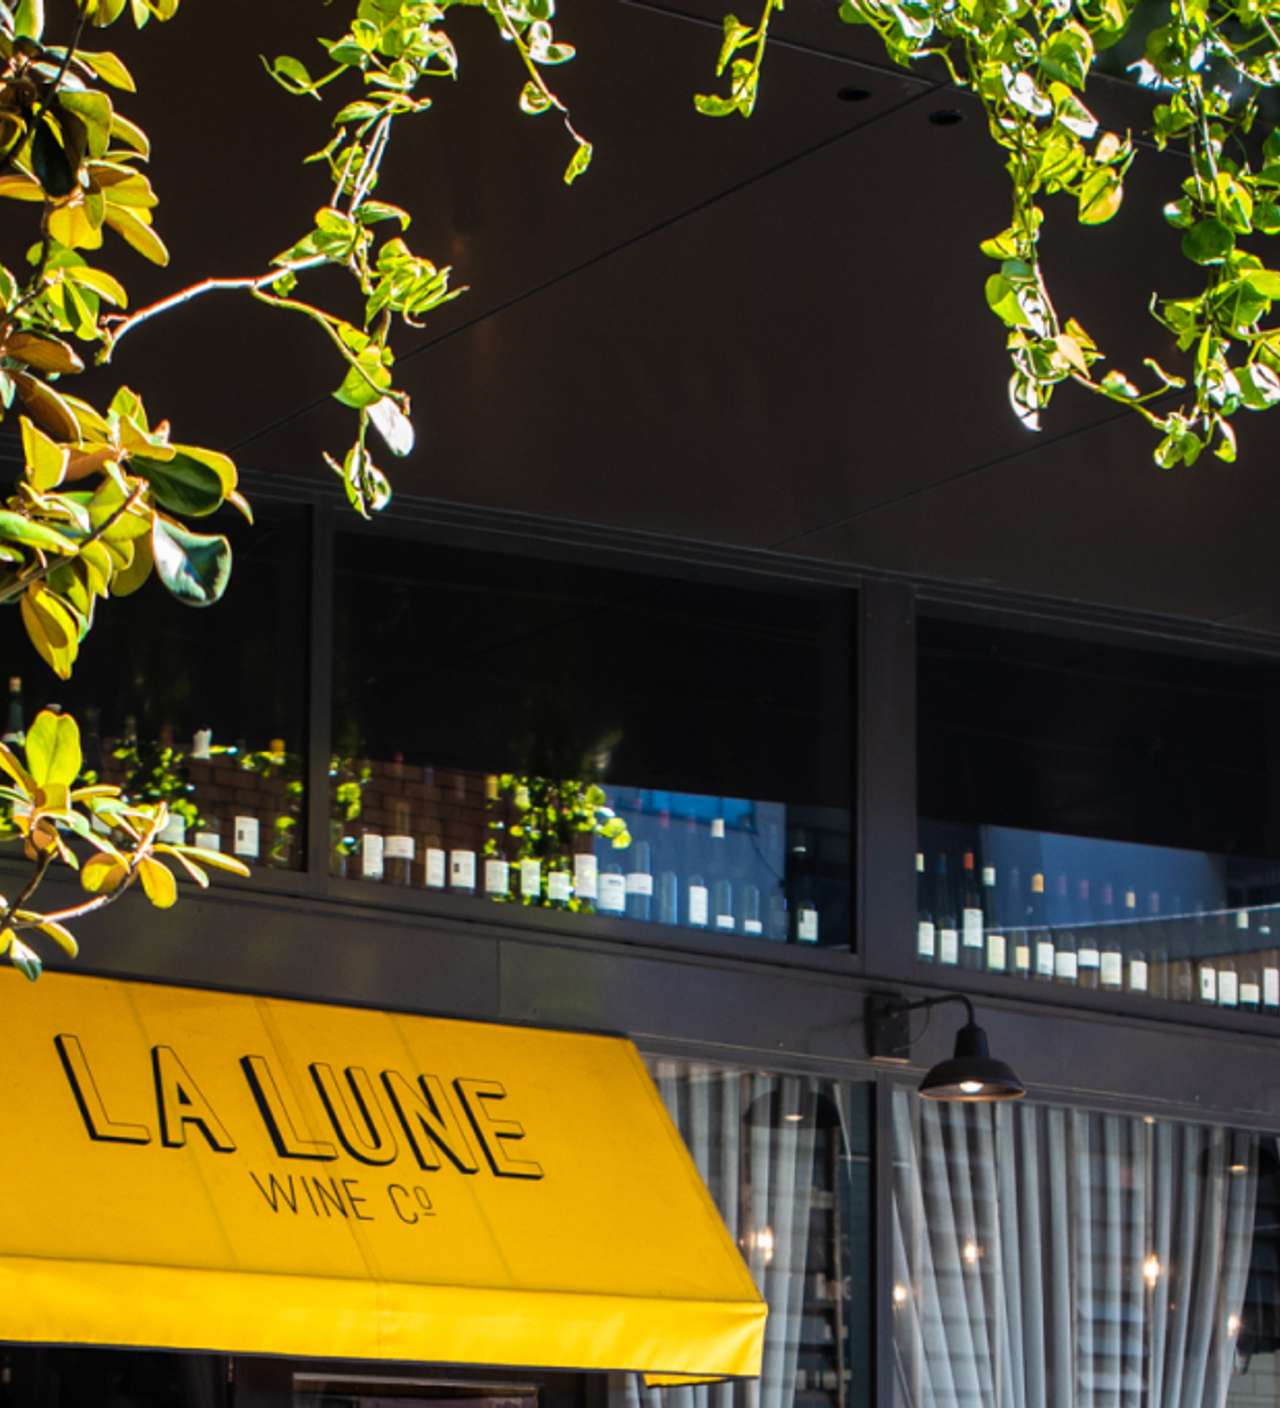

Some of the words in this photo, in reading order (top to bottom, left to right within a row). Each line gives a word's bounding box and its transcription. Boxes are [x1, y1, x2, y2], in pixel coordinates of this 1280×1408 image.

[54, 1034, 237, 1153] LA
[239, 1055, 544, 1180] LUNE
[250, 1172, 374, 1220] WINE
